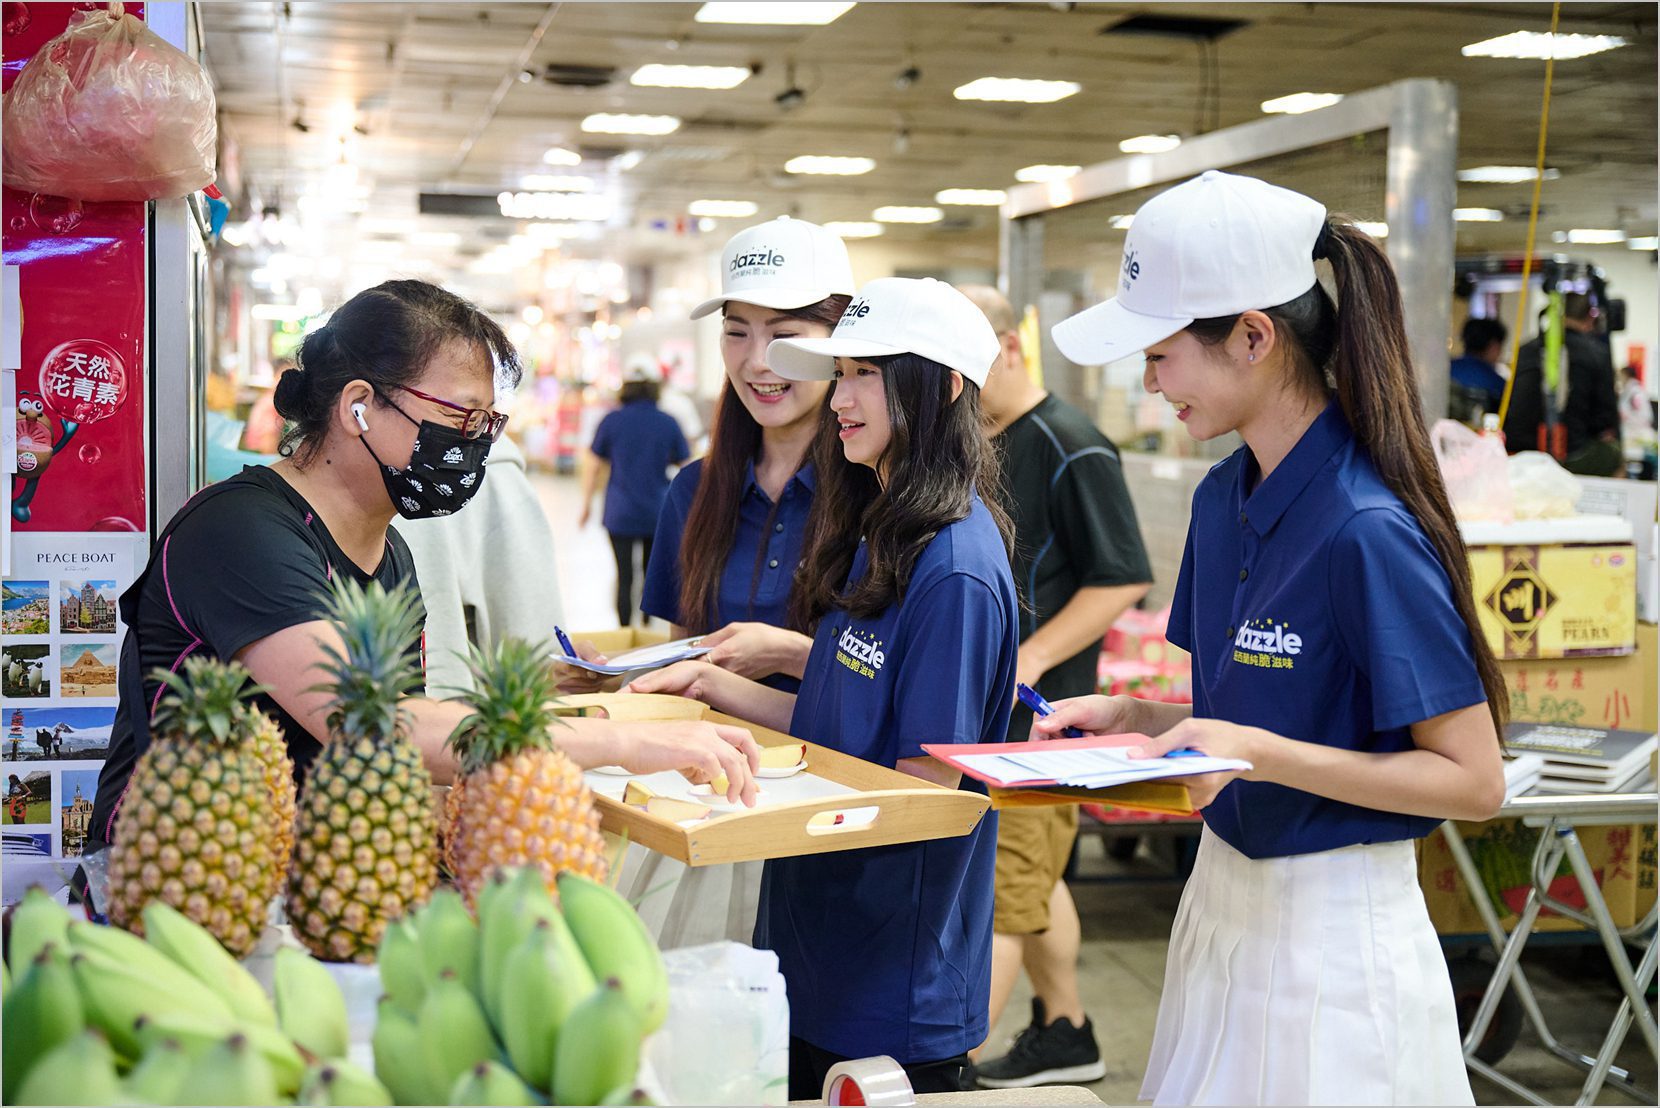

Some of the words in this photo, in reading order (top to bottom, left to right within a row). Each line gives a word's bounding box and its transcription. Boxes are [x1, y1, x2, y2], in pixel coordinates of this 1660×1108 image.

[729, 249, 785, 273] dazzle
[65, 352, 112, 380] 天然
[48, 371, 121, 406] 花青素
[37, 553, 78, 563] PEACE
[81, 553, 116, 563] BOAT
[839, 626, 885, 670] dazzle
[1235, 620, 1303, 655] dazzle
[1603, 688, 1631, 729] 小
